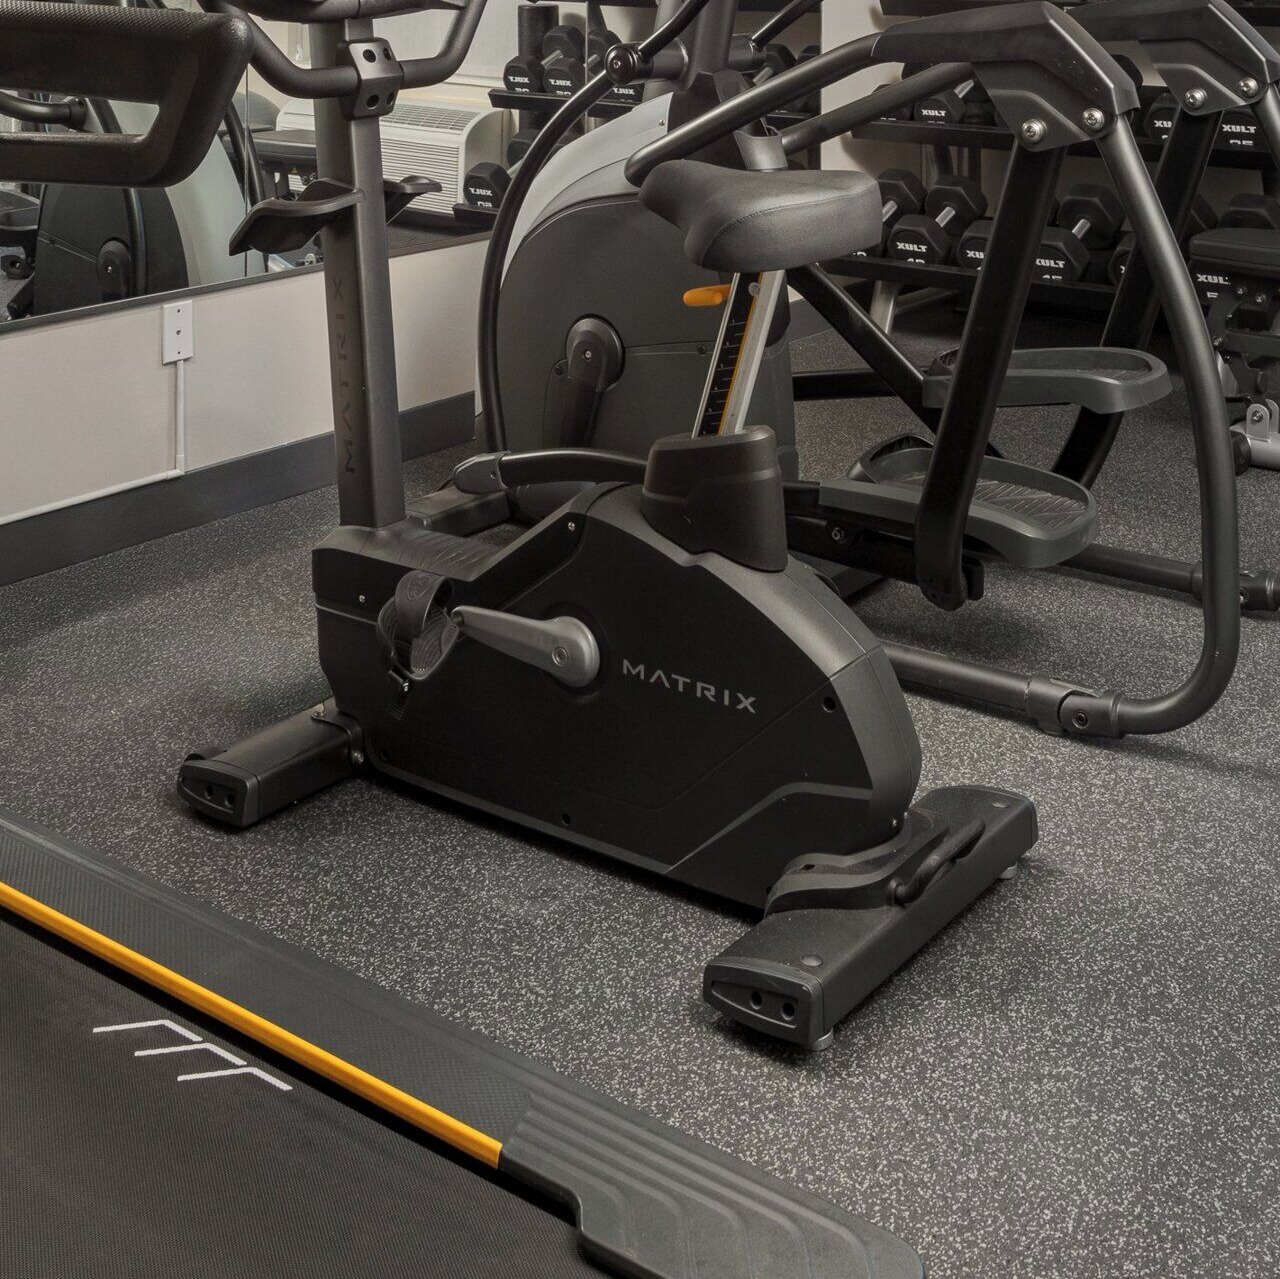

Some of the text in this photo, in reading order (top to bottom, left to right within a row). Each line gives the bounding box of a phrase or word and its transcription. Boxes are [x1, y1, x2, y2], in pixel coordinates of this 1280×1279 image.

[921, 109, 947, 117] XULT
[1154, 120, 1172, 128] XU
[1222, 124, 1257, 133] XULT
[896, 242, 928, 252] XULT
[966, 250, 984, 259] XU
[1196, 274, 1230, 285] XUL
[622, 659, 756, 714] MATRIX
